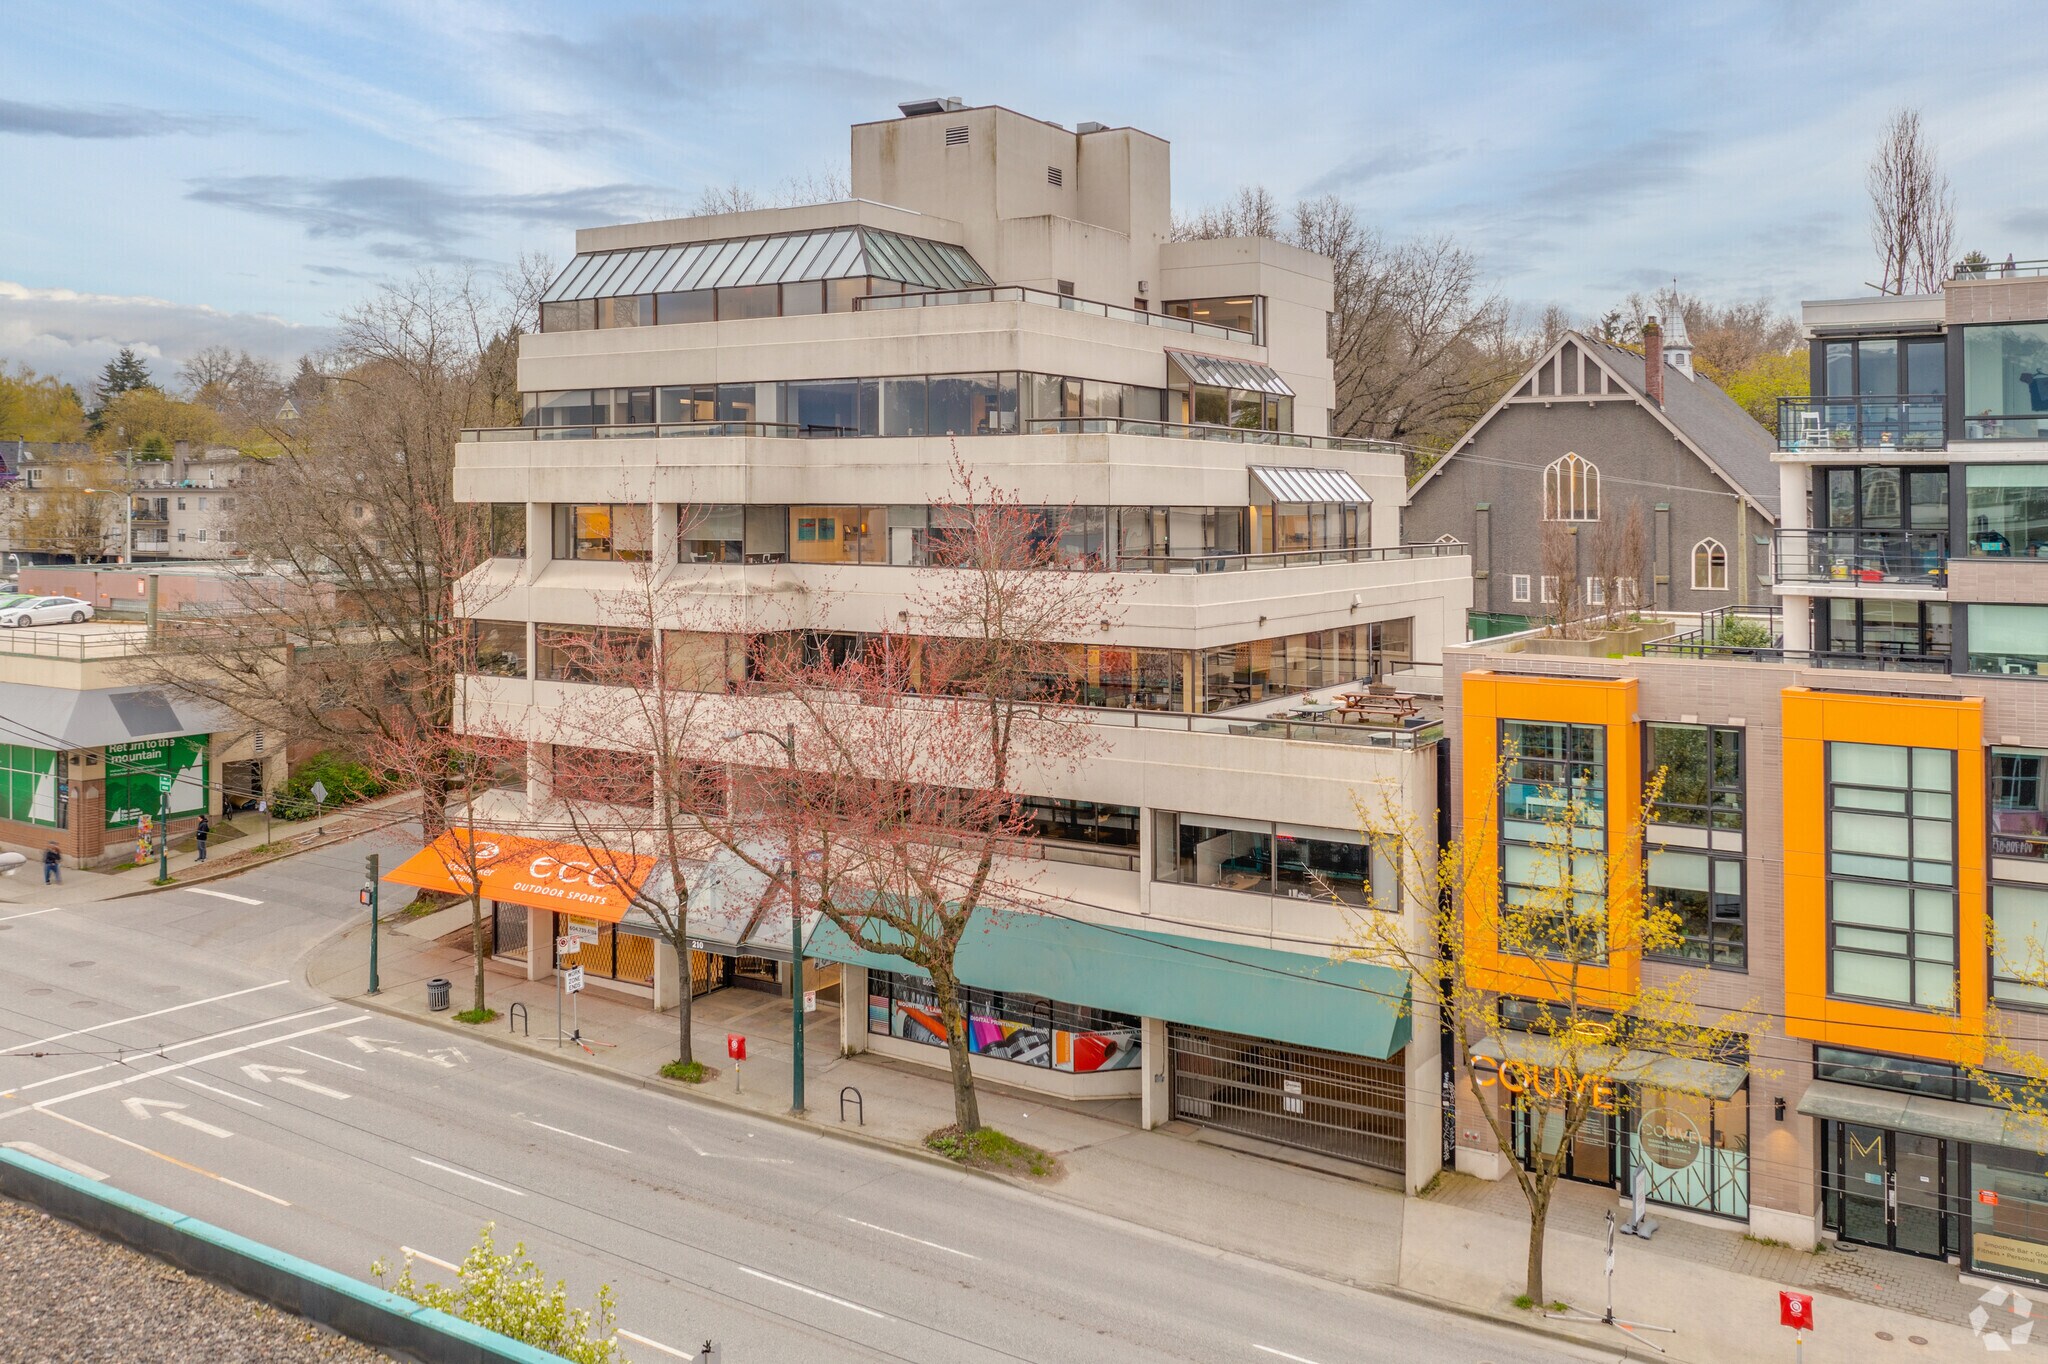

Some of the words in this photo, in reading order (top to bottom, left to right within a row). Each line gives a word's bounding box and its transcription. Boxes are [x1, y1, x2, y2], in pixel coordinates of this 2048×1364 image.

[146, 740, 157, 749] to
[157, 738, 176, 747] the
[111, 749, 162, 763] mountain
[447, 860, 495, 877] icebreker
[448, 873, 476, 885] MERIN
[513, 882, 564, 898] OUTDOOR
[566, 891, 608, 905] SPORTS
[692, 940, 704, 949] 210
[568, 969, 580, 977] WORK
[568, 976, 580, 985] ZONE
[568, 983, 581, 991] ENDS
[970, 1015, 990, 1024] DIGITAL
[990, 1019, 1015, 1029] PRINTING
[1021, 1026, 1050, 1035] FINISHING
[1471, 1055, 1614, 1110] COUVE
[1641, 1123, 1697, 1145] COUVE
[1850, 1131, 1882, 1166] M
[1976, 1246, 2001, 1257] Fitness
[2006, 1252, 2036, 1263] Personal
[1984, 1241, 2016, 1253] Smoothie
[2016, 1247, 2029, 1255] Bar
